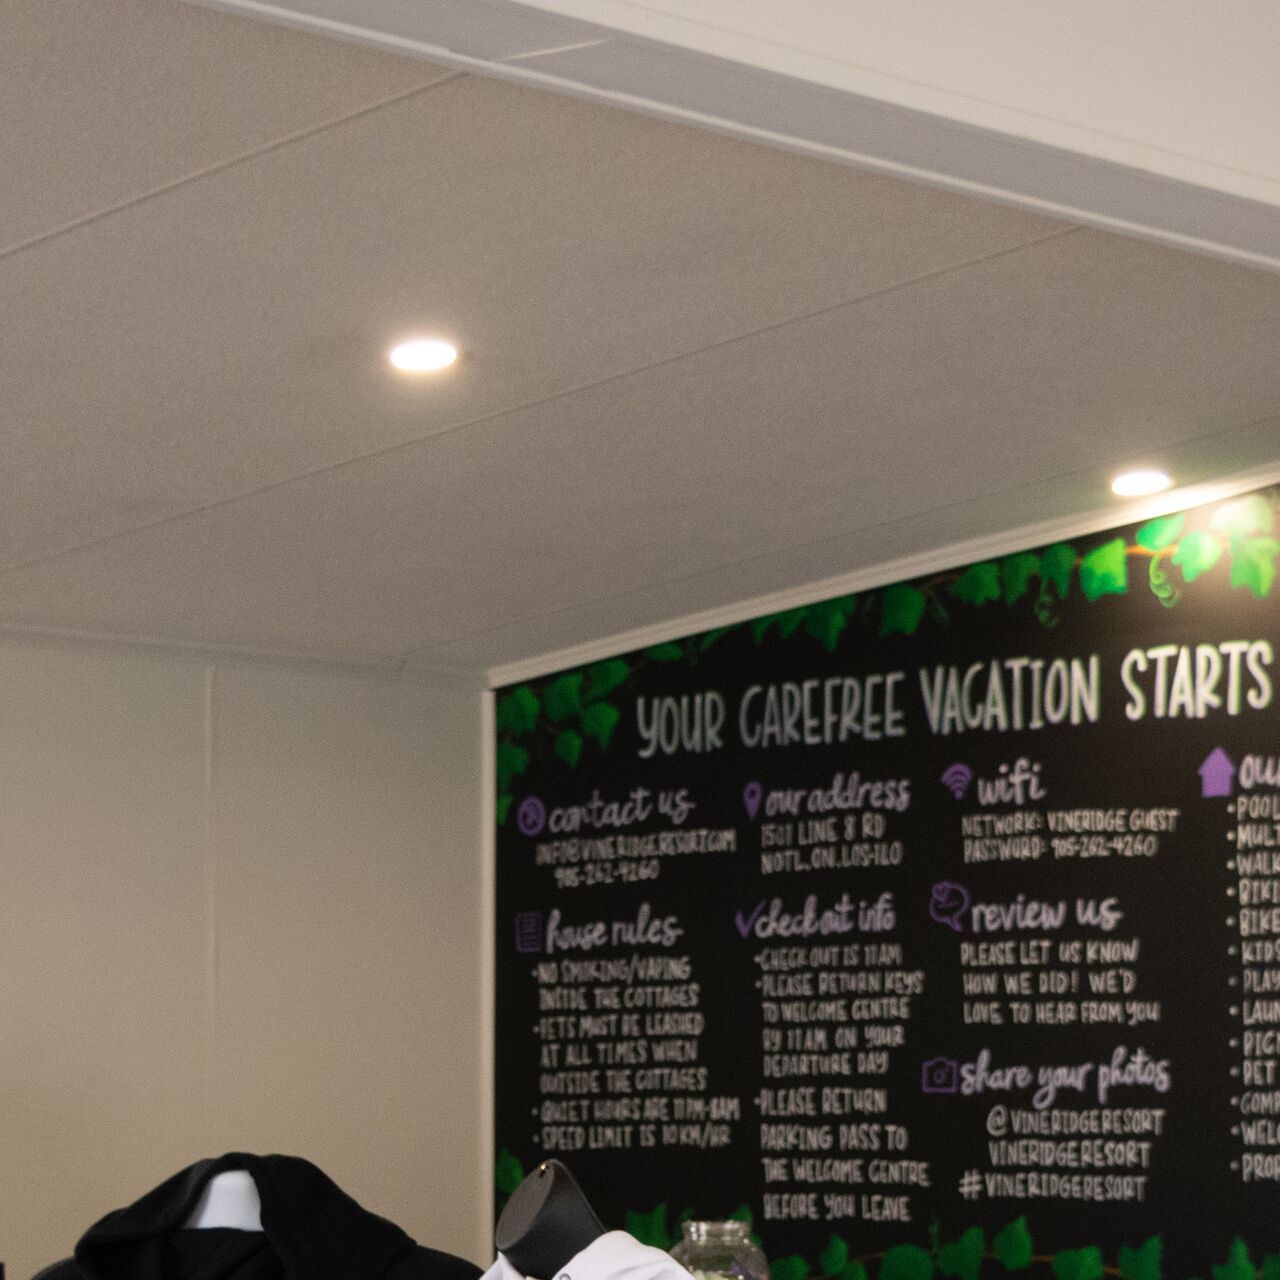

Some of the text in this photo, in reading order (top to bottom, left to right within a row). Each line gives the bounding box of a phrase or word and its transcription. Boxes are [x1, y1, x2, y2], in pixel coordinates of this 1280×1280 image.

[637, 690, 724, 758] YOUR
[740, 672, 906, 747] CAREFREE
[918, 653, 1102, 737] VACATION
[1120, 639, 1275, 722] STARTS
[763, 769, 912, 818] our address
[976, 757, 1048, 807] wifi
[548, 787, 697, 834] contact us
[1047, 810, 1126, 831] VINERIDGE
[1129, 809, 1179, 830] GUEST
[754, 890, 896, 939] check out info
[971, 894, 1125, 934] review us
[546, 901, 685, 955] house rules
[758, 944, 902, 970] CHECK OUT IS 11AM
[960, 941, 1139, 965] PLEASE LET US KNOW
[761, 972, 925, 996] PLEASE RETURN KEYS
[963, 974, 997, 993] HOW
[1003, 972, 1031, 994] WE
[1039, 971, 1078, 993] DID!
[761, 998, 909, 1022] TO WELCOME CENTRE
[963, 1001, 1160, 1024] LOVE TO HEAR FROM YOU
[538, 1013, 704, 1039] PETS MUST BE LEASHED
[763, 1025, 904, 1051] BY 11AM ON YOUR
[541, 1040, 697, 1066] AT ALL TIMES WHEN
[763, 1052, 889, 1076] DEPARTURE DAY
[959, 1044, 1172, 1110] share your photos
[1242, 1060, 1275, 1084] PET
[760, 1089, 887, 1115] PLEASE RETURN
[760, 1126, 908, 1149] PARKING PASS TO
[761, 1159, 929, 1185] THE WELCOME CENTRE
[958, 1172, 1146, 1199] #VINERIDGERESORT
[763, 1196, 910, 1221] BEFORE YOU LEAVE
